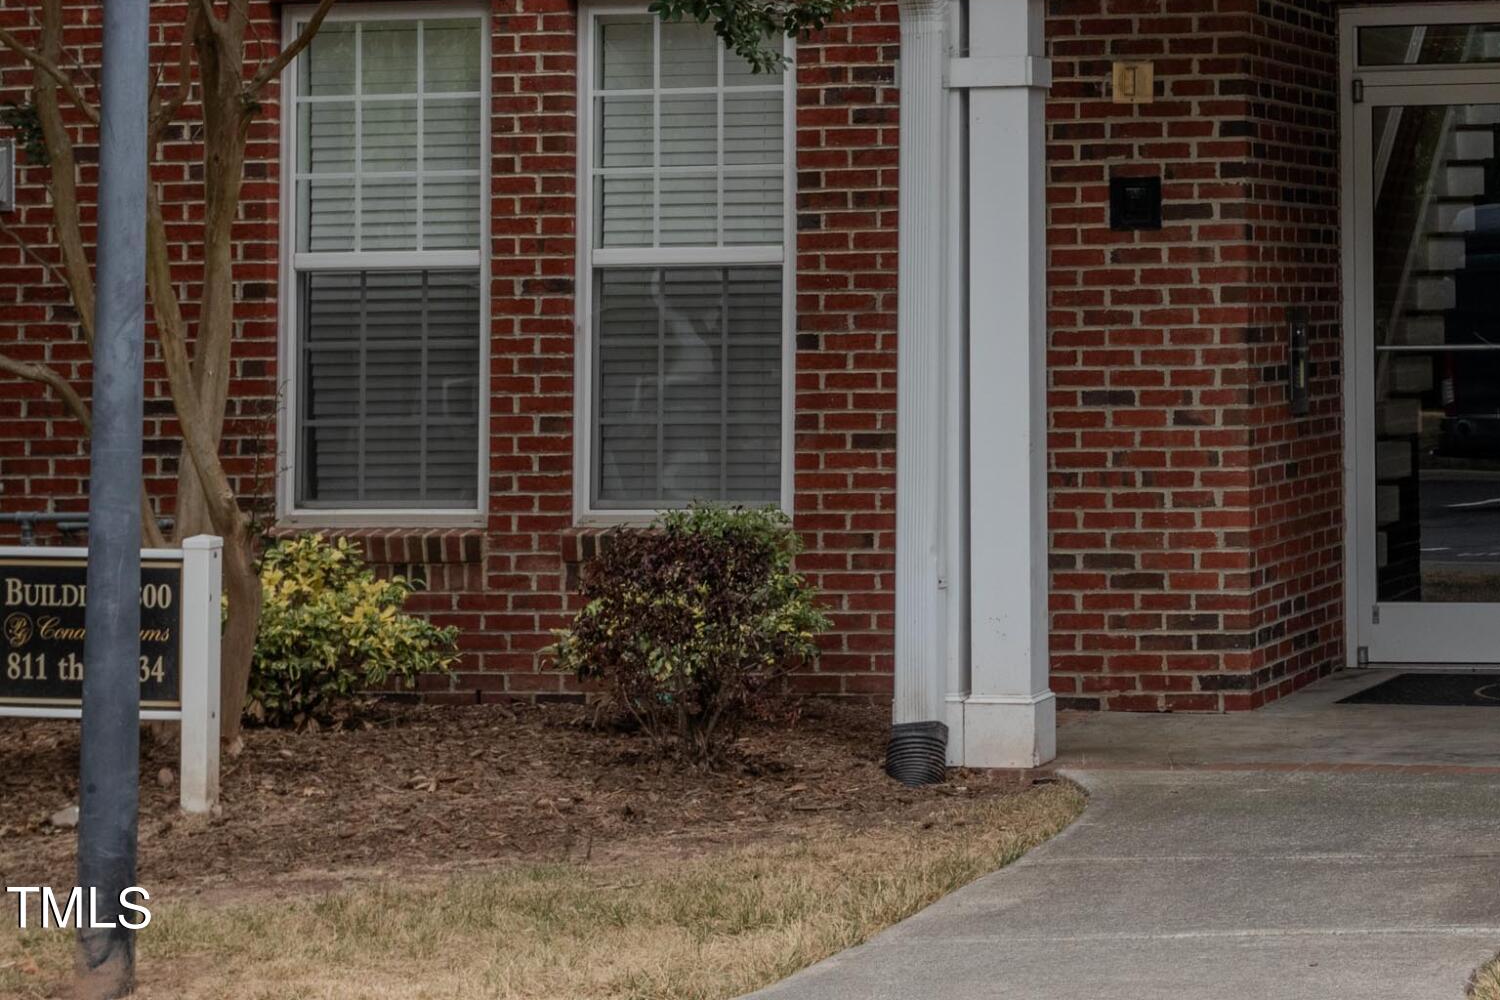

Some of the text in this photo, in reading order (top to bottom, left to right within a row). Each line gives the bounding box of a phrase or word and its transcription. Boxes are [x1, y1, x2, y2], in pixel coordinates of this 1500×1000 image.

[5, 578, 172, 609] BUILDI 00
[7, 652, 47, 680] 811
[138, 655, 165, 683] 34
